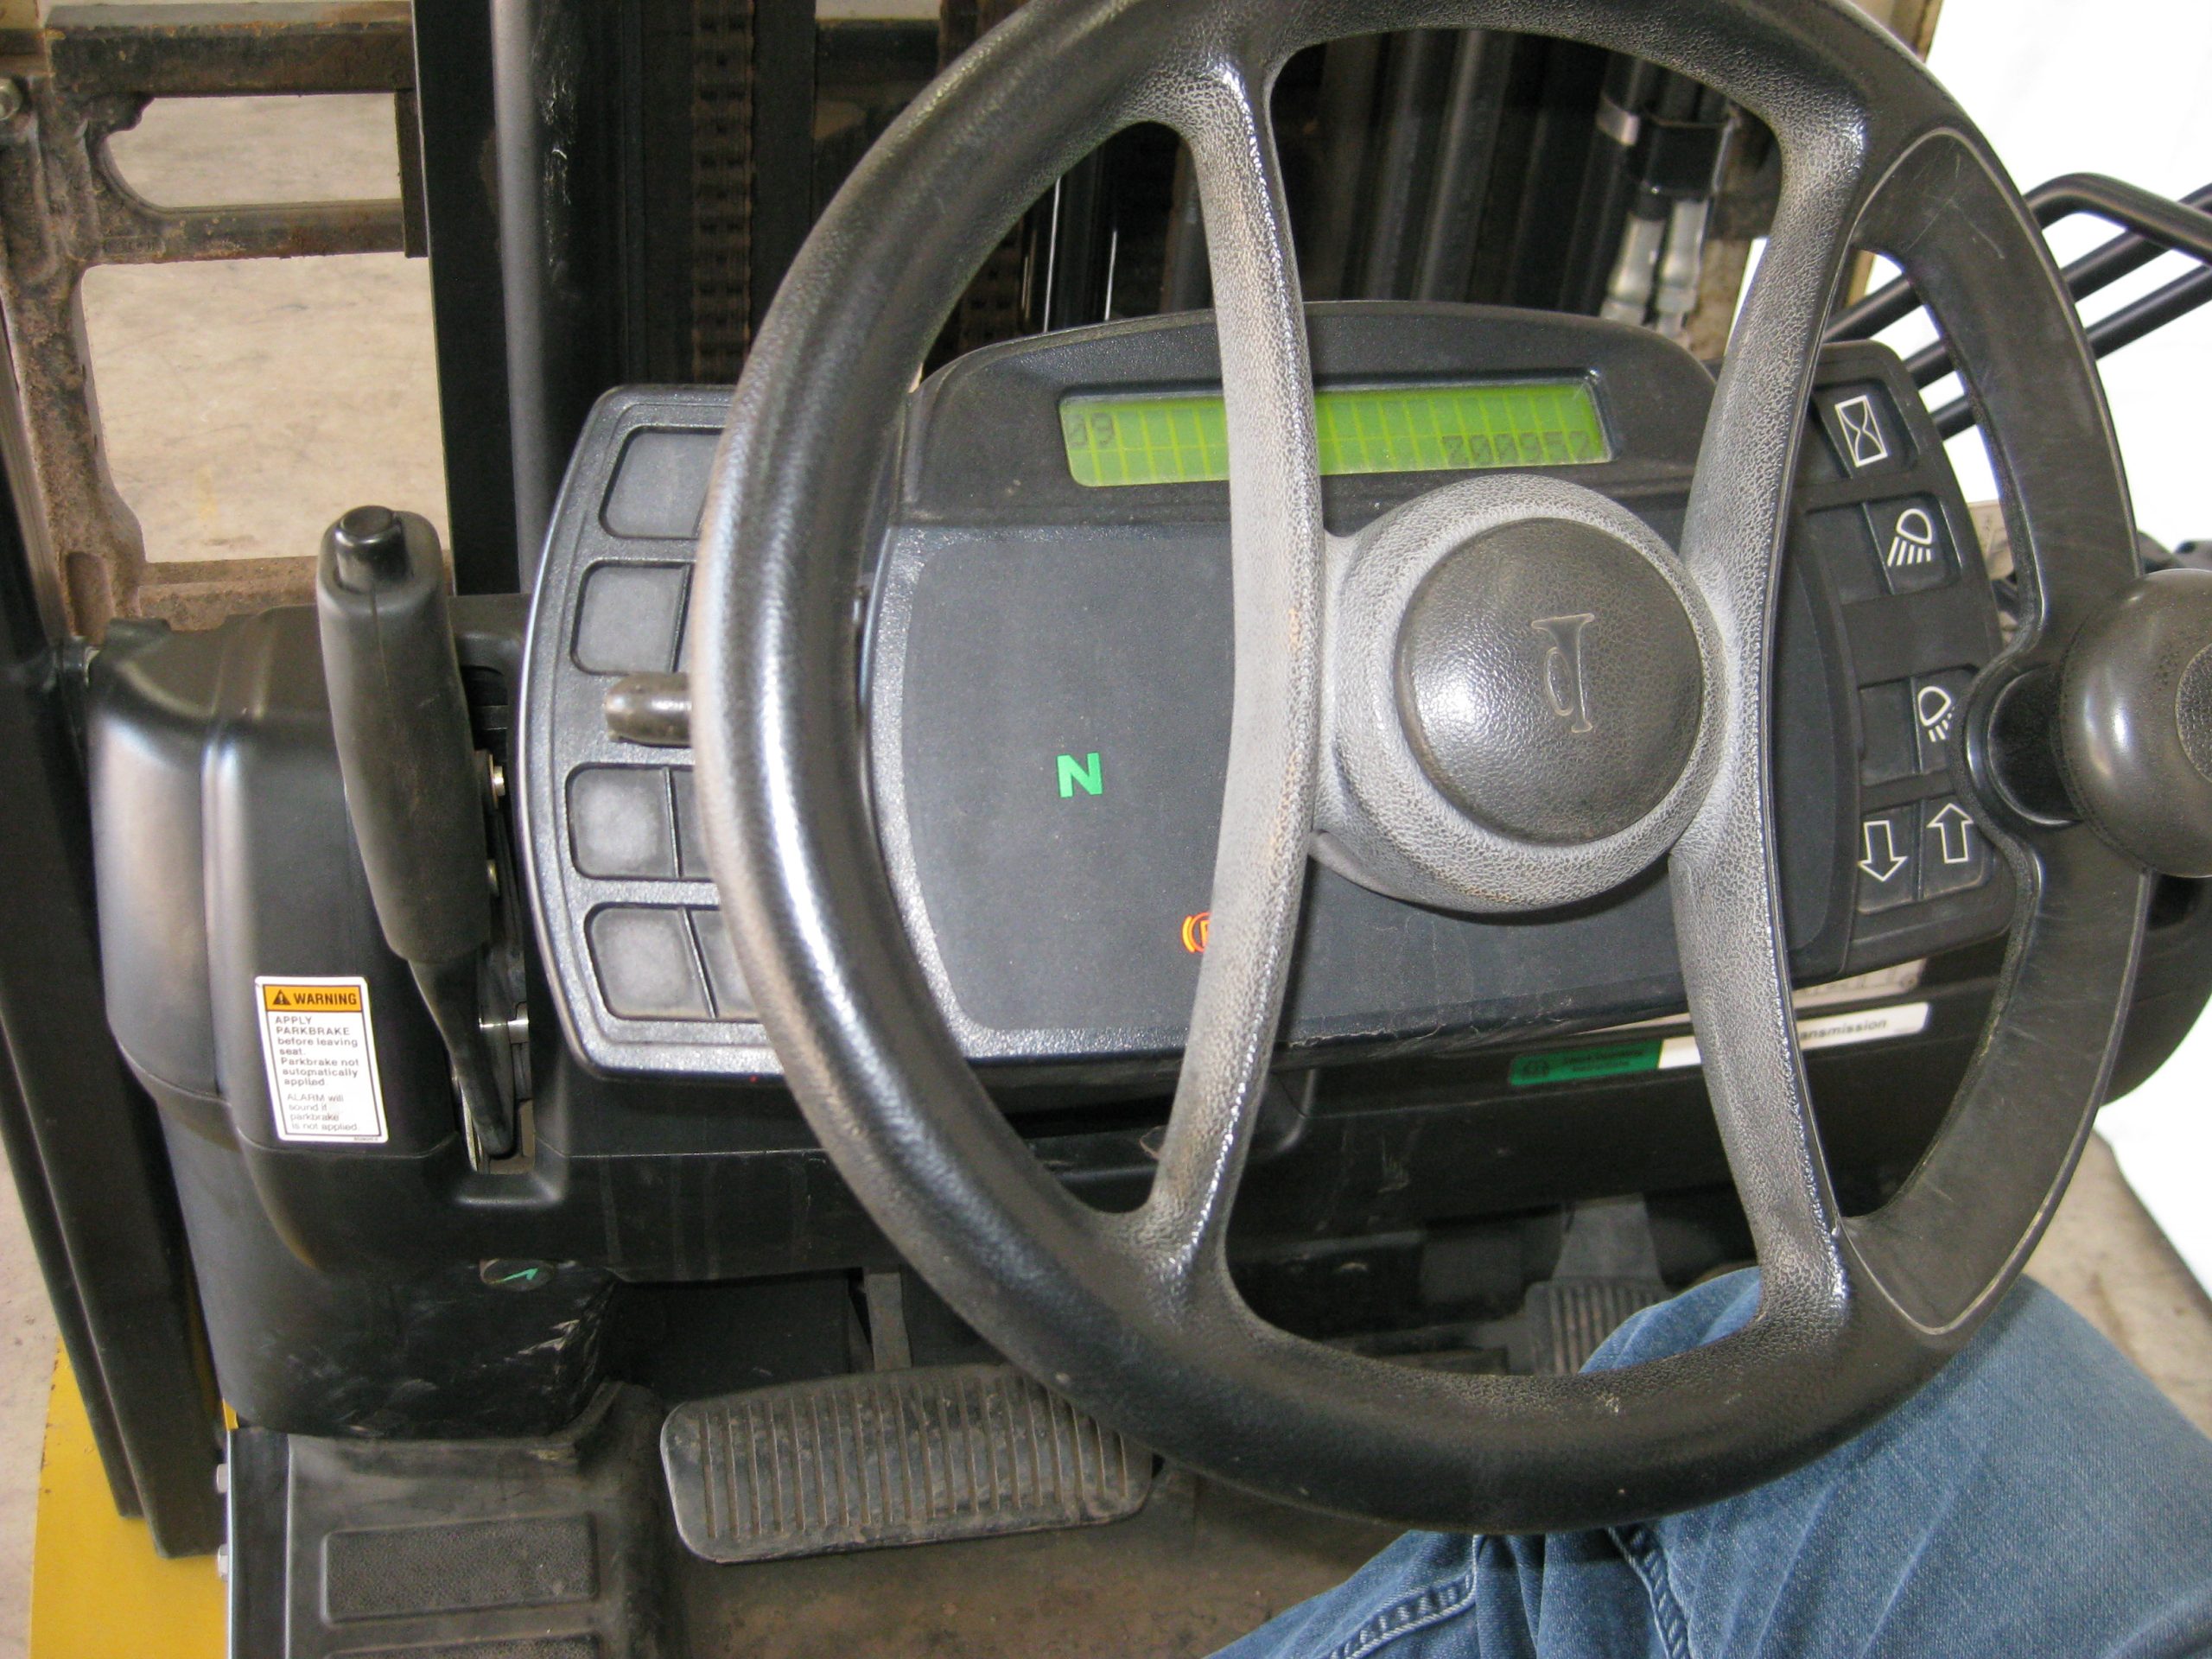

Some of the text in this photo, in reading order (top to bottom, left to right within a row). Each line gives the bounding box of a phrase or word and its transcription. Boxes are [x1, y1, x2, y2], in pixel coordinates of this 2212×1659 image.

[1057, 752, 1103, 798] N
[294, 993, 357, 1005] WARNING
[275, 1016, 312, 1025] APPLY
[276, 1027, 350, 1036] PARKBRAKE
[1799, 1020, 1887, 1039] ansmission
[277, 1037, 359, 1048] before leaving
[281, 1057, 338, 1066] Parkbrake
[283, 1068, 359, 1078] automatically
[287, 1093, 344, 1103] ALARM will
[289, 1103, 319, 1111] sound
[289, 1112, 340, 1122] parkbrake
[302, 1122, 319, 1131] not
